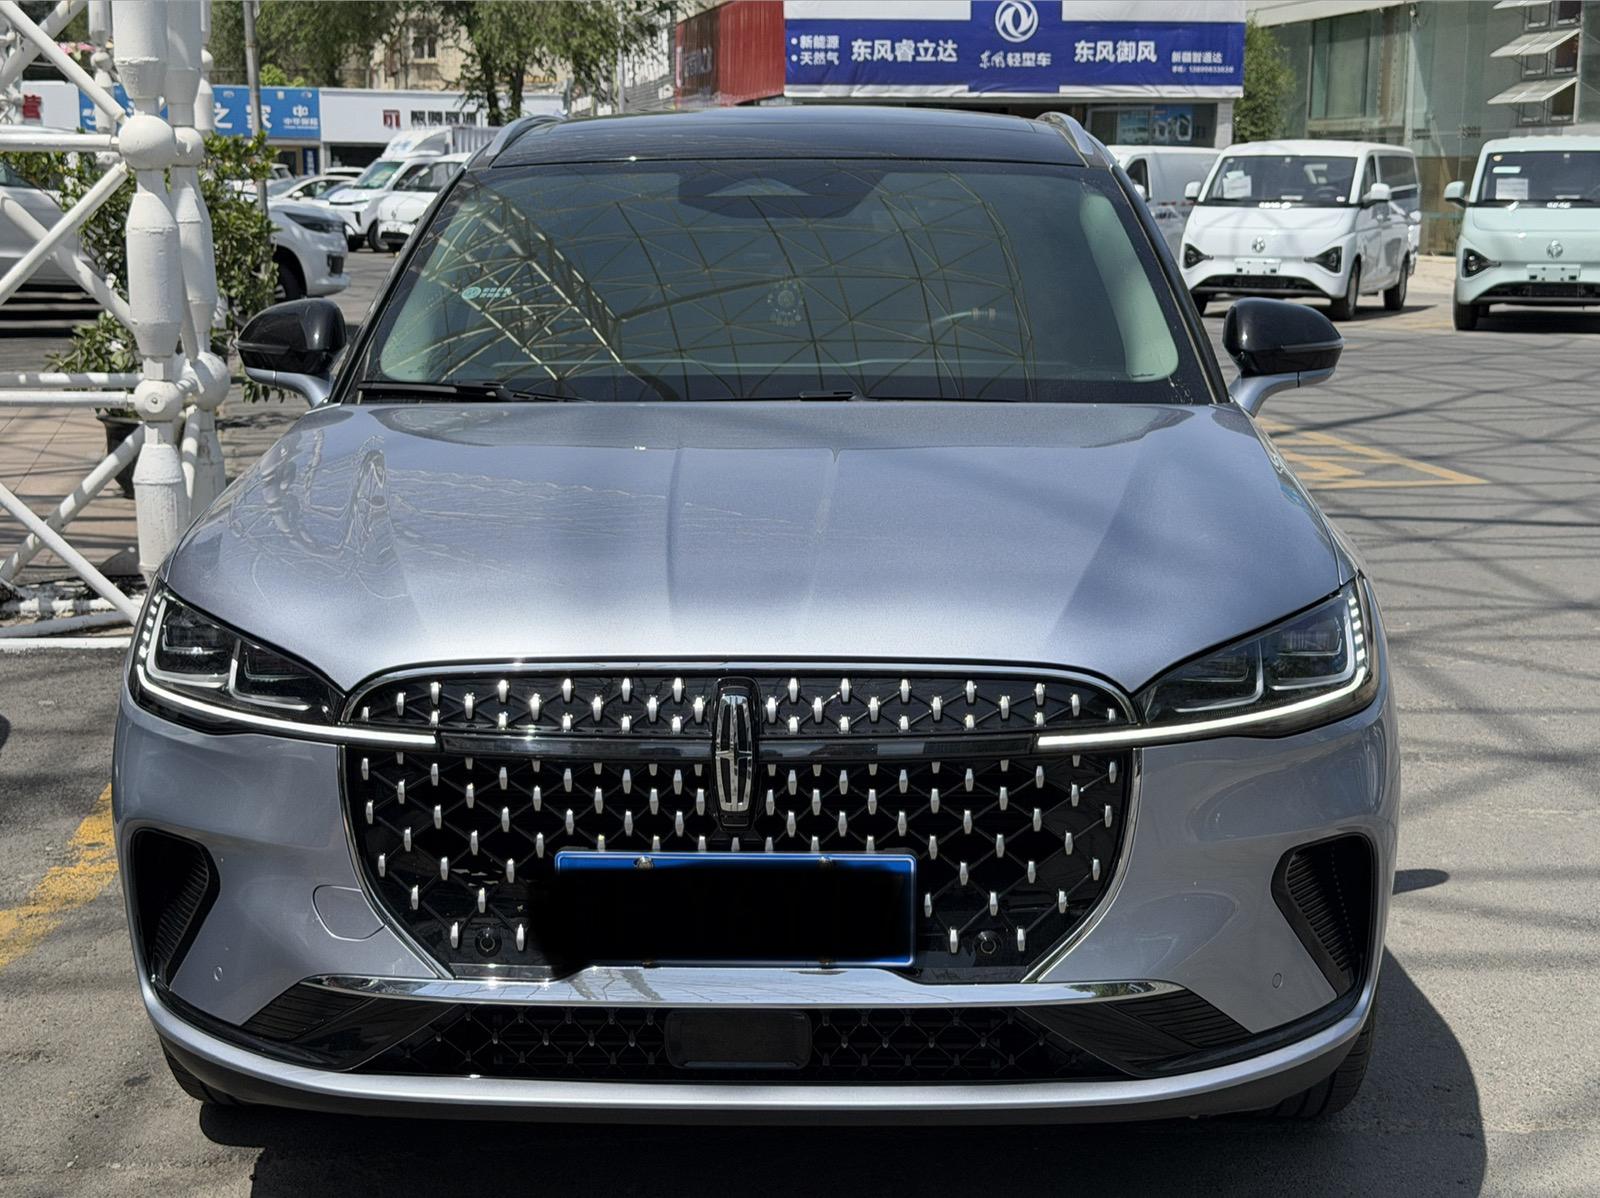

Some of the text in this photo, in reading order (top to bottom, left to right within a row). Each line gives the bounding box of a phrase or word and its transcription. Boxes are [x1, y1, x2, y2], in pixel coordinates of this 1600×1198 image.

[800, 35, 839, 49] 新能源
[851, 39, 958, 62] 东风睿立达
[800, 52, 839, 65] 天然气
[1074, 40, 1157, 63] 东风御风
